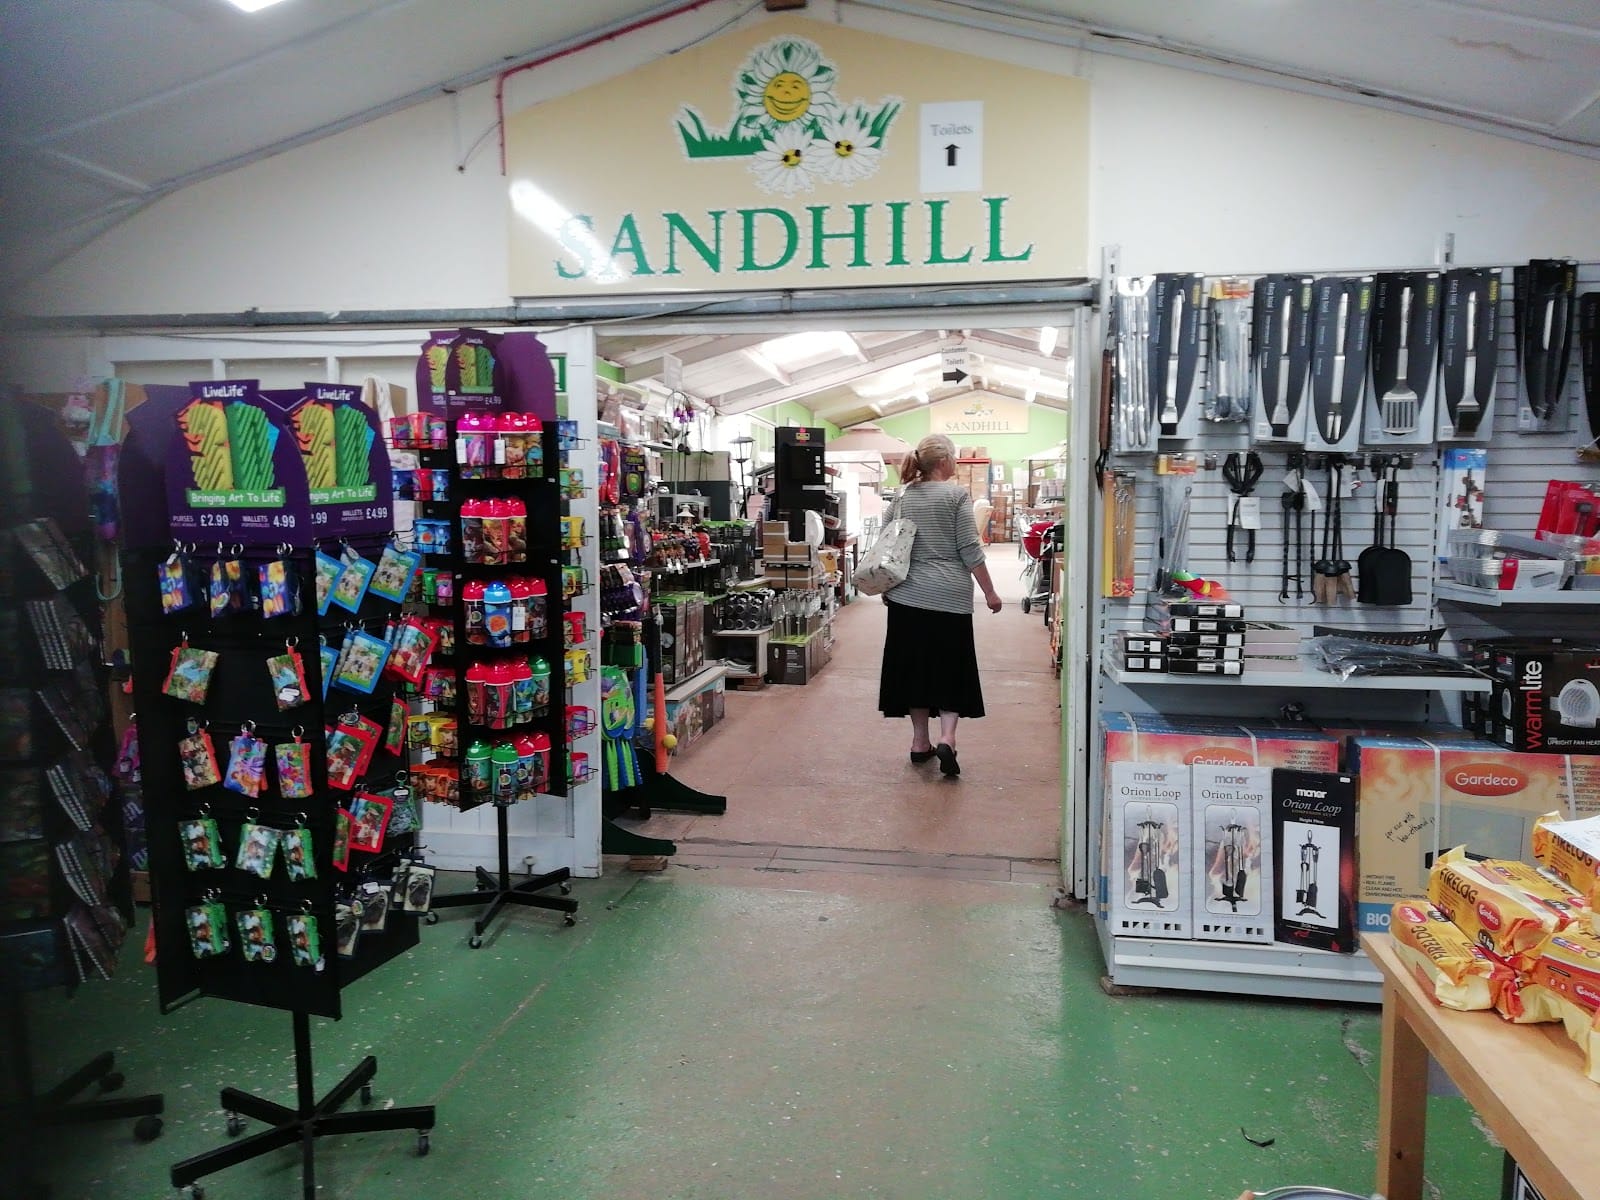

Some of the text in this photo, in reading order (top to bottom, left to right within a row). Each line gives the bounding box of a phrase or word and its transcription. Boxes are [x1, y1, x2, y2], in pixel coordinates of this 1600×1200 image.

[930, 123, 974, 137] Toilets
[556, 197, 1034, 280] SANDHILL
[945, 358, 965, 366] Toilets
[945, 421, 1010, 432] SANDHILL
[191, 491, 281, 505] Bringing Art To Life
[331, 490, 345, 498] Art
[347, 488, 357, 497] To
[358, 487, 373, 497] Life
[365, 507, 388, 519] £4.99
[200, 514, 230, 527] £2.99
[273, 515, 296, 528] 4.99
[1520, 660, 1543, 750] warmlite
[1133, 772, 1168, 782] manor
[1214, 775, 1250, 785] manor
[1455, 772, 1519, 787] Gardeco
[1120, 786, 1182, 801] Orion Loop
[1201, 789, 1264, 804] Orion Loop
[1296, 788, 1328, 799] manor
[1282, 798, 1342, 817] Orion Loop
[1439, 868, 1478, 905] FIRELOG
[1366, 912, 1391, 926] BIO
[1478, 903, 1499, 927] Gardeco
